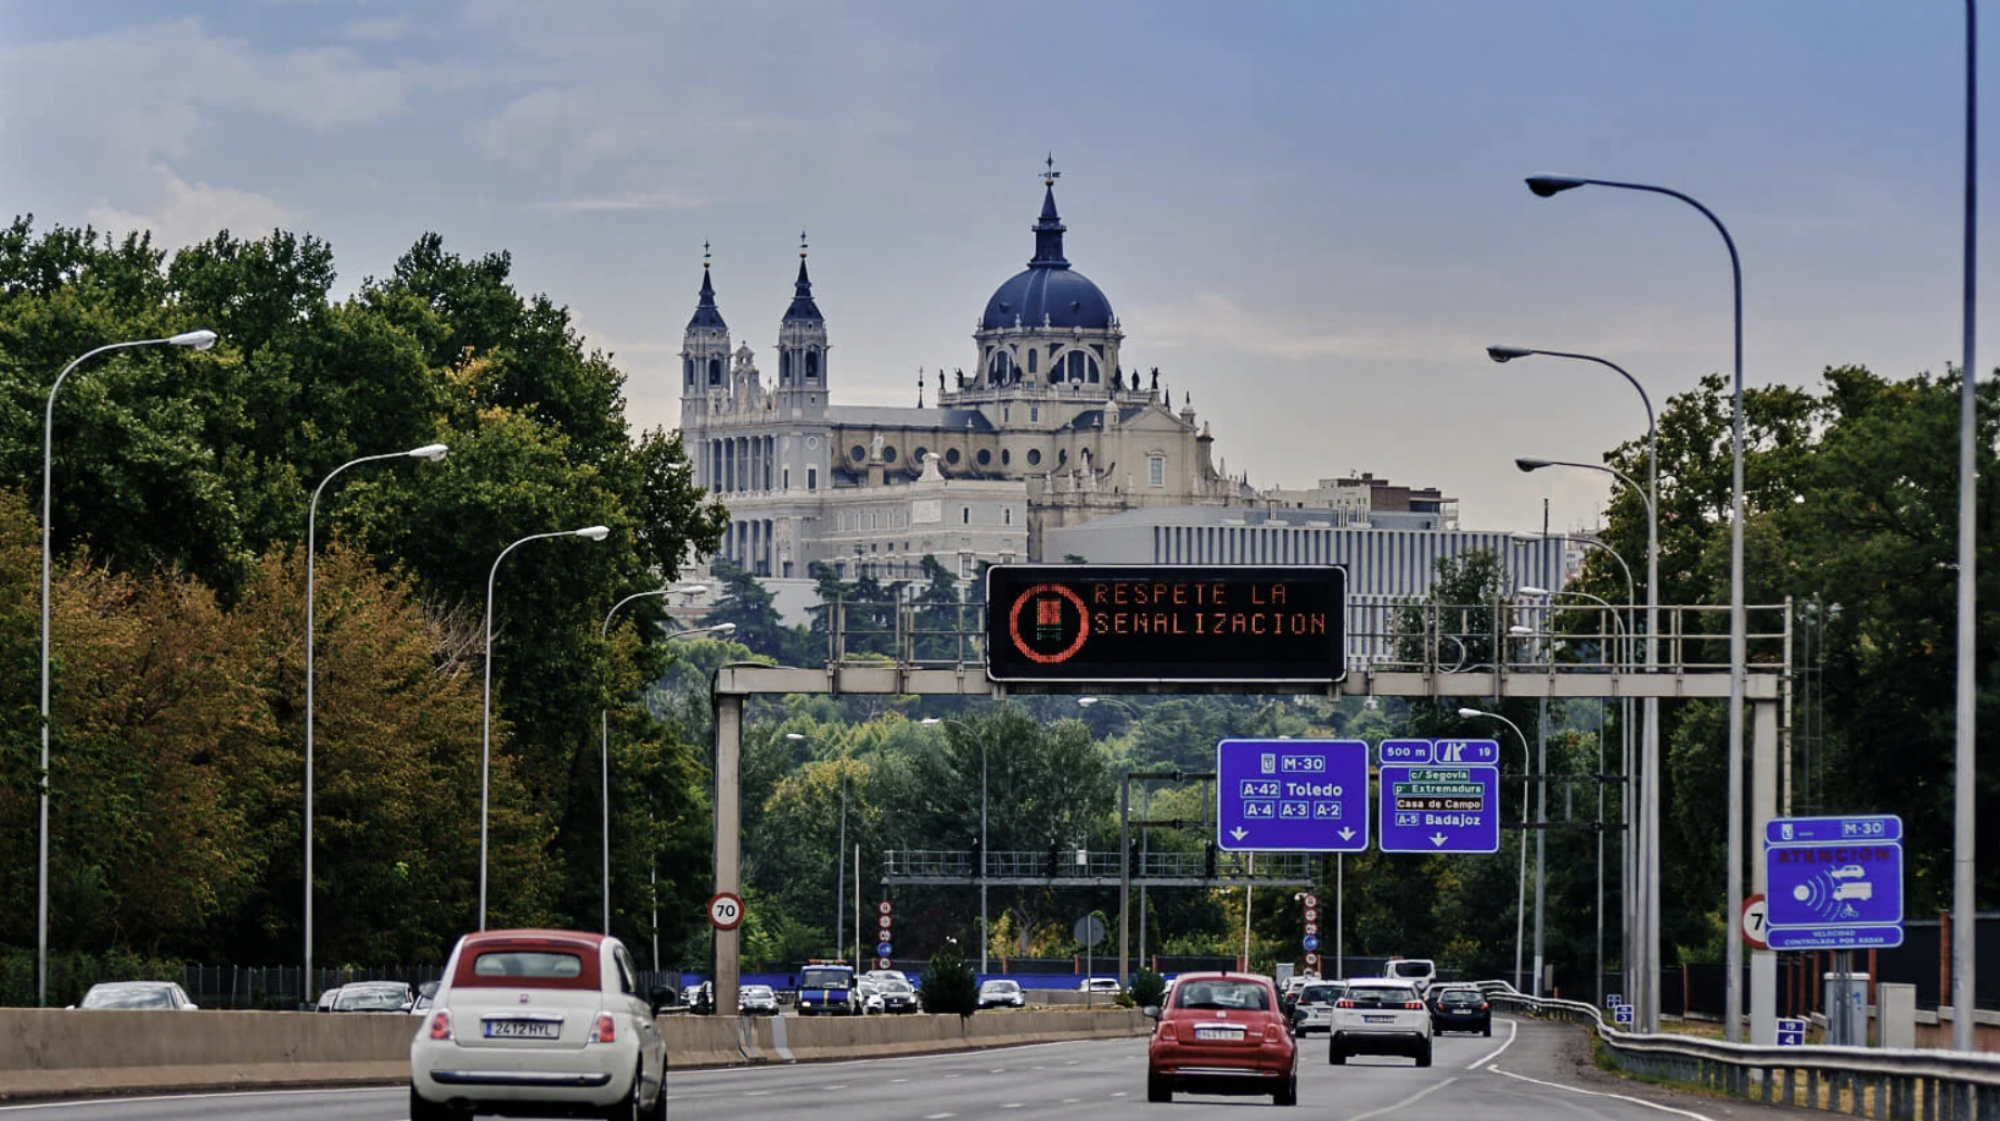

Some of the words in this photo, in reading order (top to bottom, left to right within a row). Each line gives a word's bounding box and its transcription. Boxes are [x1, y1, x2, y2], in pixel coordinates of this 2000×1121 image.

[1094, 583, 1227, 604] RESPETE
[1252, 583, 1285, 604] LA
[1387, 747, 1411, 757] 500
[1415, 749, 1426, 757] m
[1479, 747, 1491, 757] 19
[1284, 758, 1323, 770] M-30
[1243, 783, 1278, 796] A-42
[1286, 782, 1343, 796] Toledo
[1412, 785, 1481, 793] Extremadura
[1247, 803, 1272, 816] A-4
[1282, 803, 1307, 816] A-3
[1317, 803, 1340, 816] A-2
[1397, 799, 1425, 809] Casa
[1428, 799, 1442, 809] de
[1445, 799, 1481, 811] Campo
[1398, 815, 1418, 825] A-5
[1425, 814, 1482, 827] Badajoz
[1844, 822, 1882, 835] M-30
[716, 904, 736, 917] 70
[1751, 912, 1764, 931] 7
